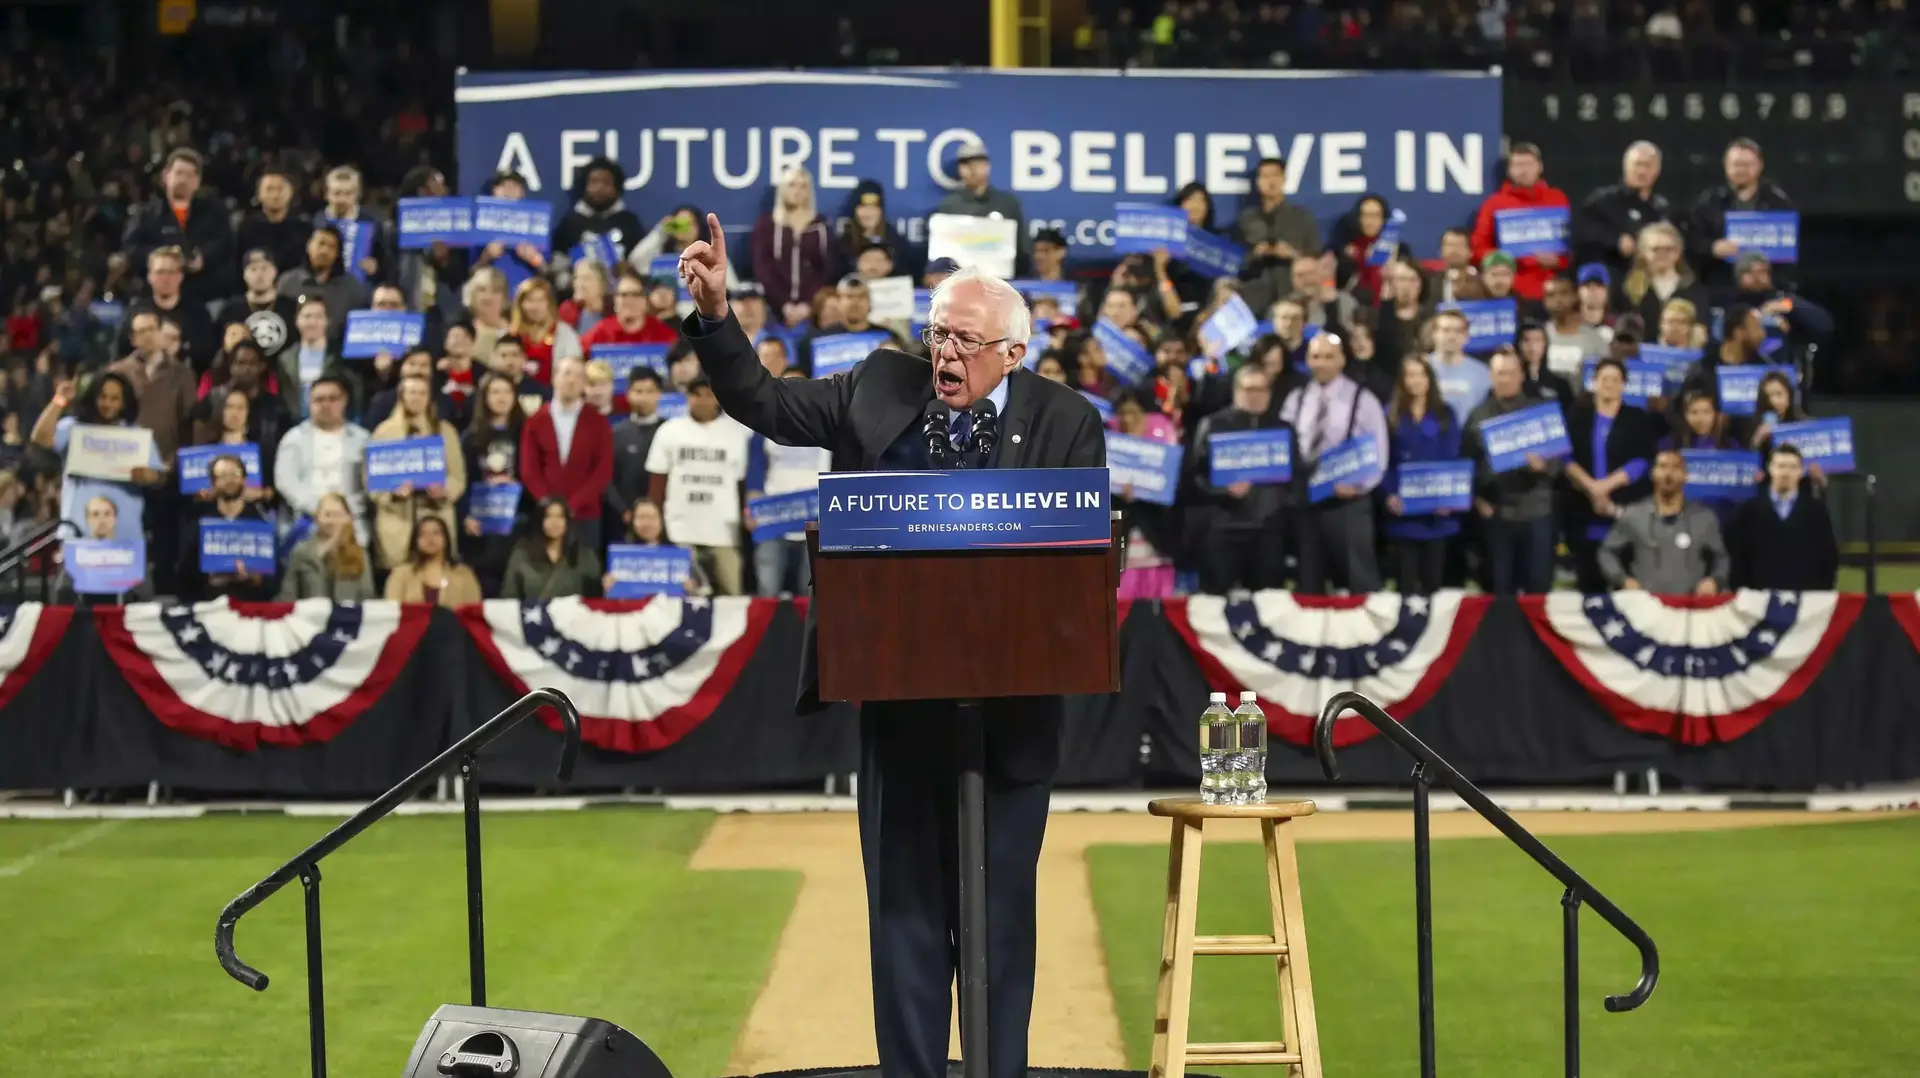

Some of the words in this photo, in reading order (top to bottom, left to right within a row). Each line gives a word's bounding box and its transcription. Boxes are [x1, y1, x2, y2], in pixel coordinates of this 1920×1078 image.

[1543, 94, 1560, 120] 1
[1578, 93, 1598, 121] 2
[1613, 93, 1634, 121] 3
[1649, 94, 1669, 120] 4
[1684, 94, 1704, 120] 5
[1720, 93, 1740, 120] 6
[1756, 94, 1775, 120] 7
[1791, 93, 1811, 120] 8
[1827, 93, 1847, 120] 9
[497, 131, 541, 191] A
[561, 128, 859, 190] FUTURE
[876, 129, 985, 188] TO
[1395, 130, 1483, 194] IN
[828, 495, 842, 512] A
[848, 494, 929, 511] FUTURE
[935, 493, 964, 510] TO
[971, 492, 1068, 510] BELIEVE
[1076, 491, 1100, 508] IN
[908, 522, 1022, 532] BERNIESANDERS.COM
